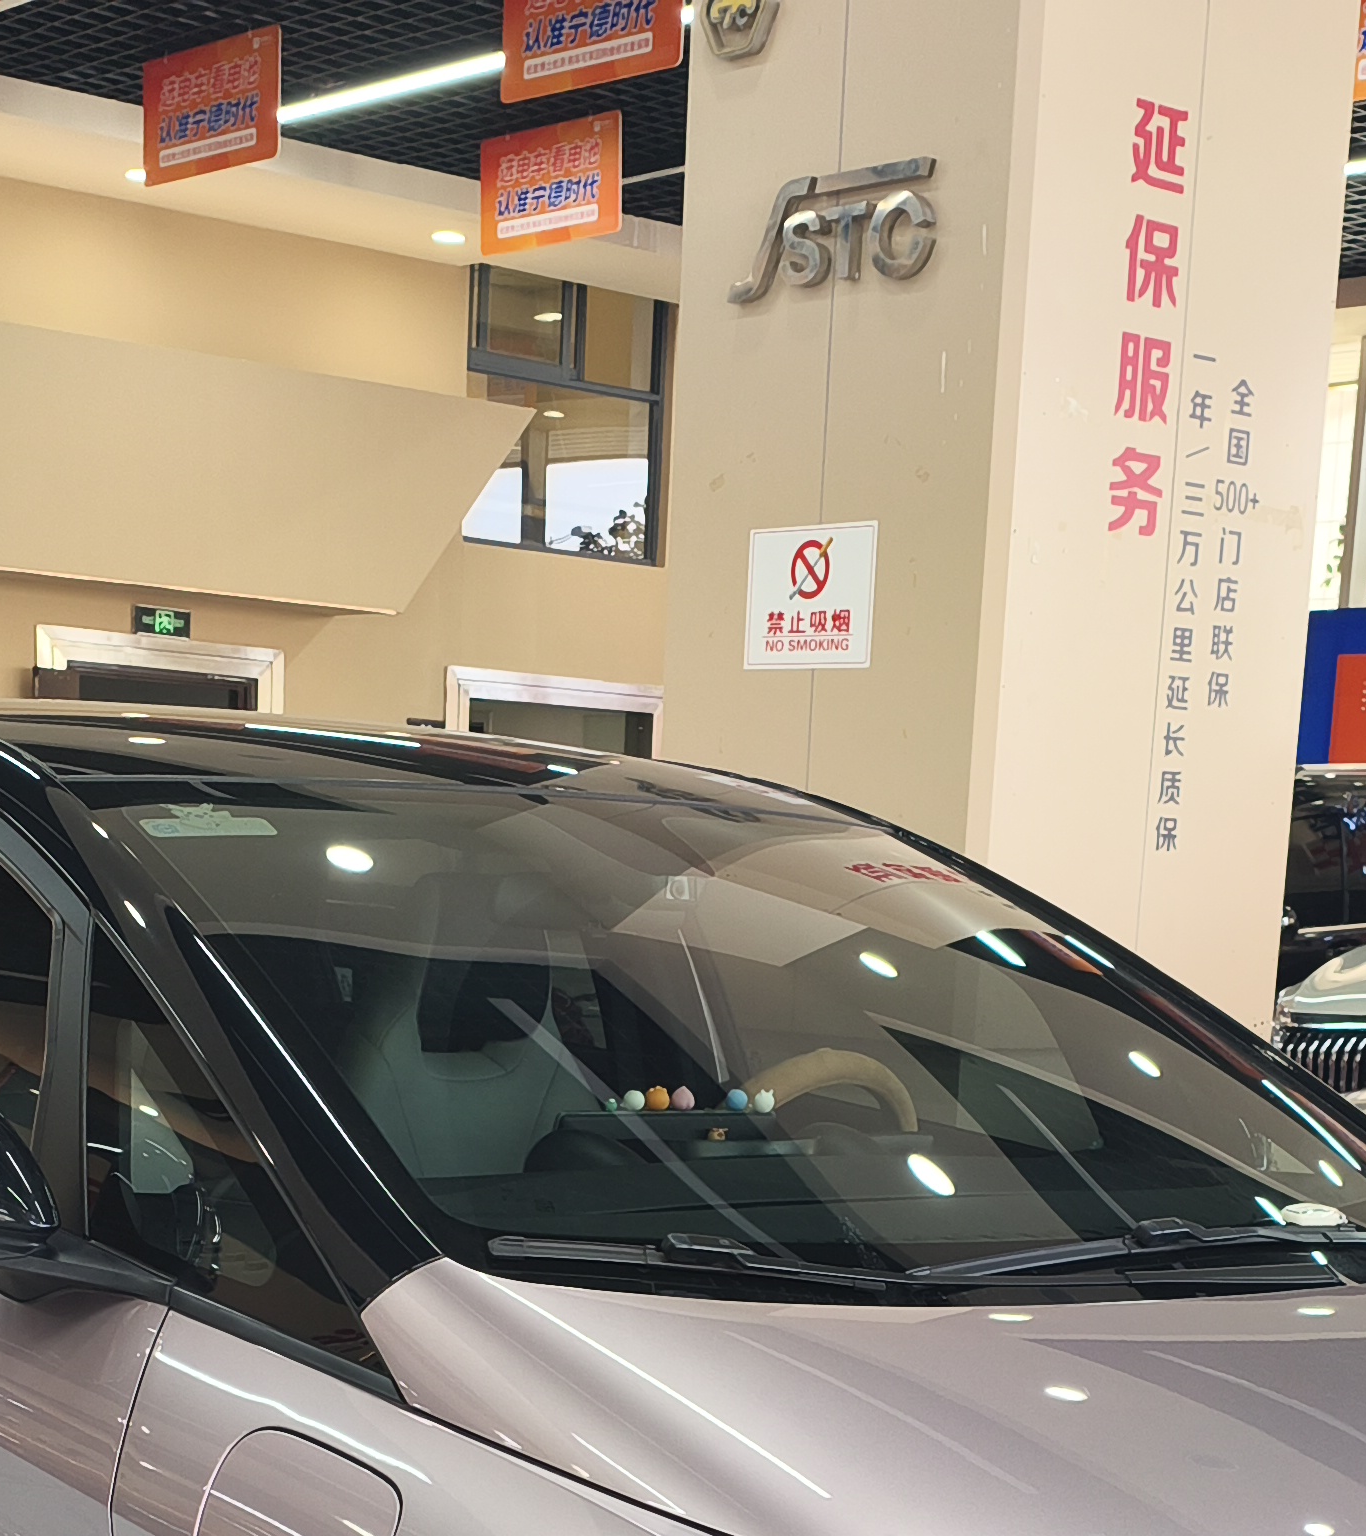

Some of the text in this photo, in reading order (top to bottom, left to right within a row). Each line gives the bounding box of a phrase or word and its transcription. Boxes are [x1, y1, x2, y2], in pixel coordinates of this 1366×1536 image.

[1107, 97, 1190, 537] 延保服务
[767, 609, 851, 635] 禁止吸烟
[765, 637, 850, 652] NO SMOKING
